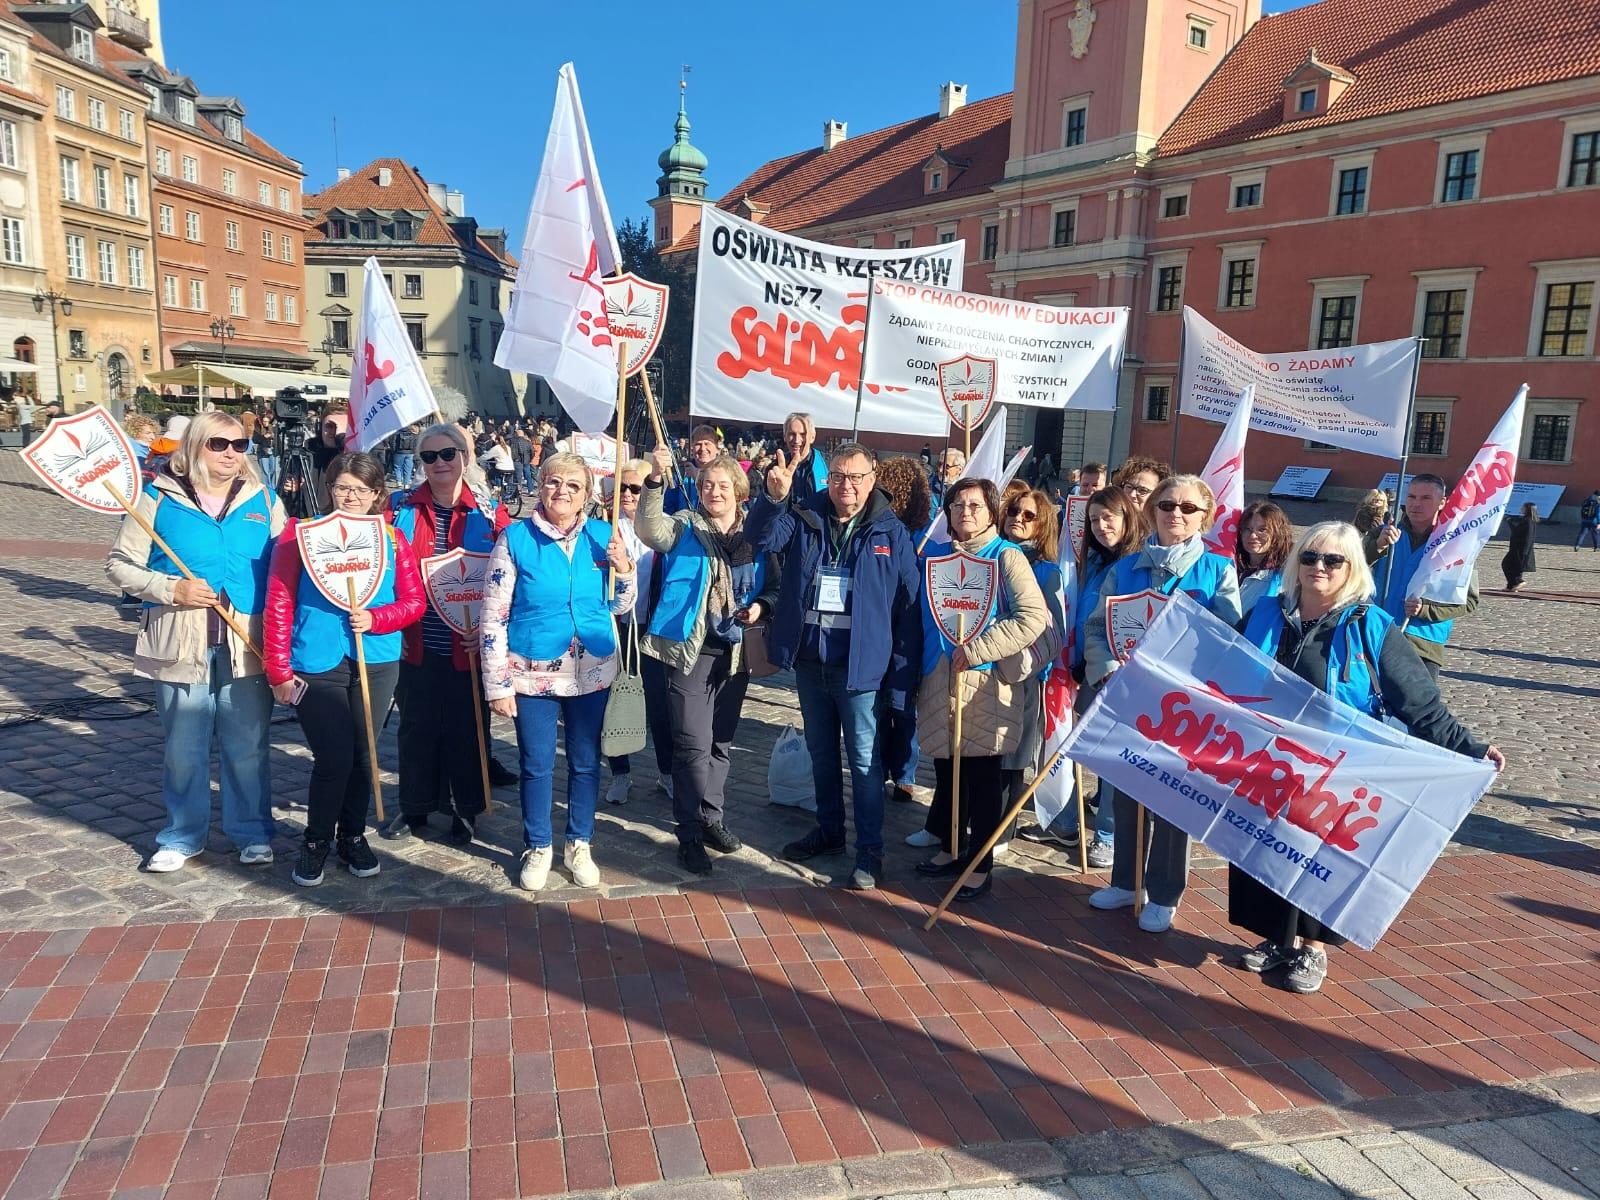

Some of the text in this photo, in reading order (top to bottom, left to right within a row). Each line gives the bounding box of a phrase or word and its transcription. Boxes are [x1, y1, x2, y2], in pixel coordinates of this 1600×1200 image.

[764, 281, 823, 311] NSZZ
[874, 280, 1116, 326] STOP CHAOSOWI W EDUKACJI
[889, 313, 933, 330] ŻĄDAMY
[1008, 335, 1095, 351] CHAOTYCZNYCH,
[1020, 352, 1056, 363] ZMIAN
[1288, 356, 1356, 373] ŻĄDAMY
[1263, 419, 1297, 434] zdrowia
[1347, 425, 1379, 438] urlopu
[32, 452, 119, 508] SEKCJA KRAJOWA
[303, 529, 348, 602] SEKCJA KRAJOWA
[1118, 747, 1159, 777] NSZZ
[1158, 770, 1223, 815] REGION
[1222, 808, 1334, 883] RZESZOWSKI
